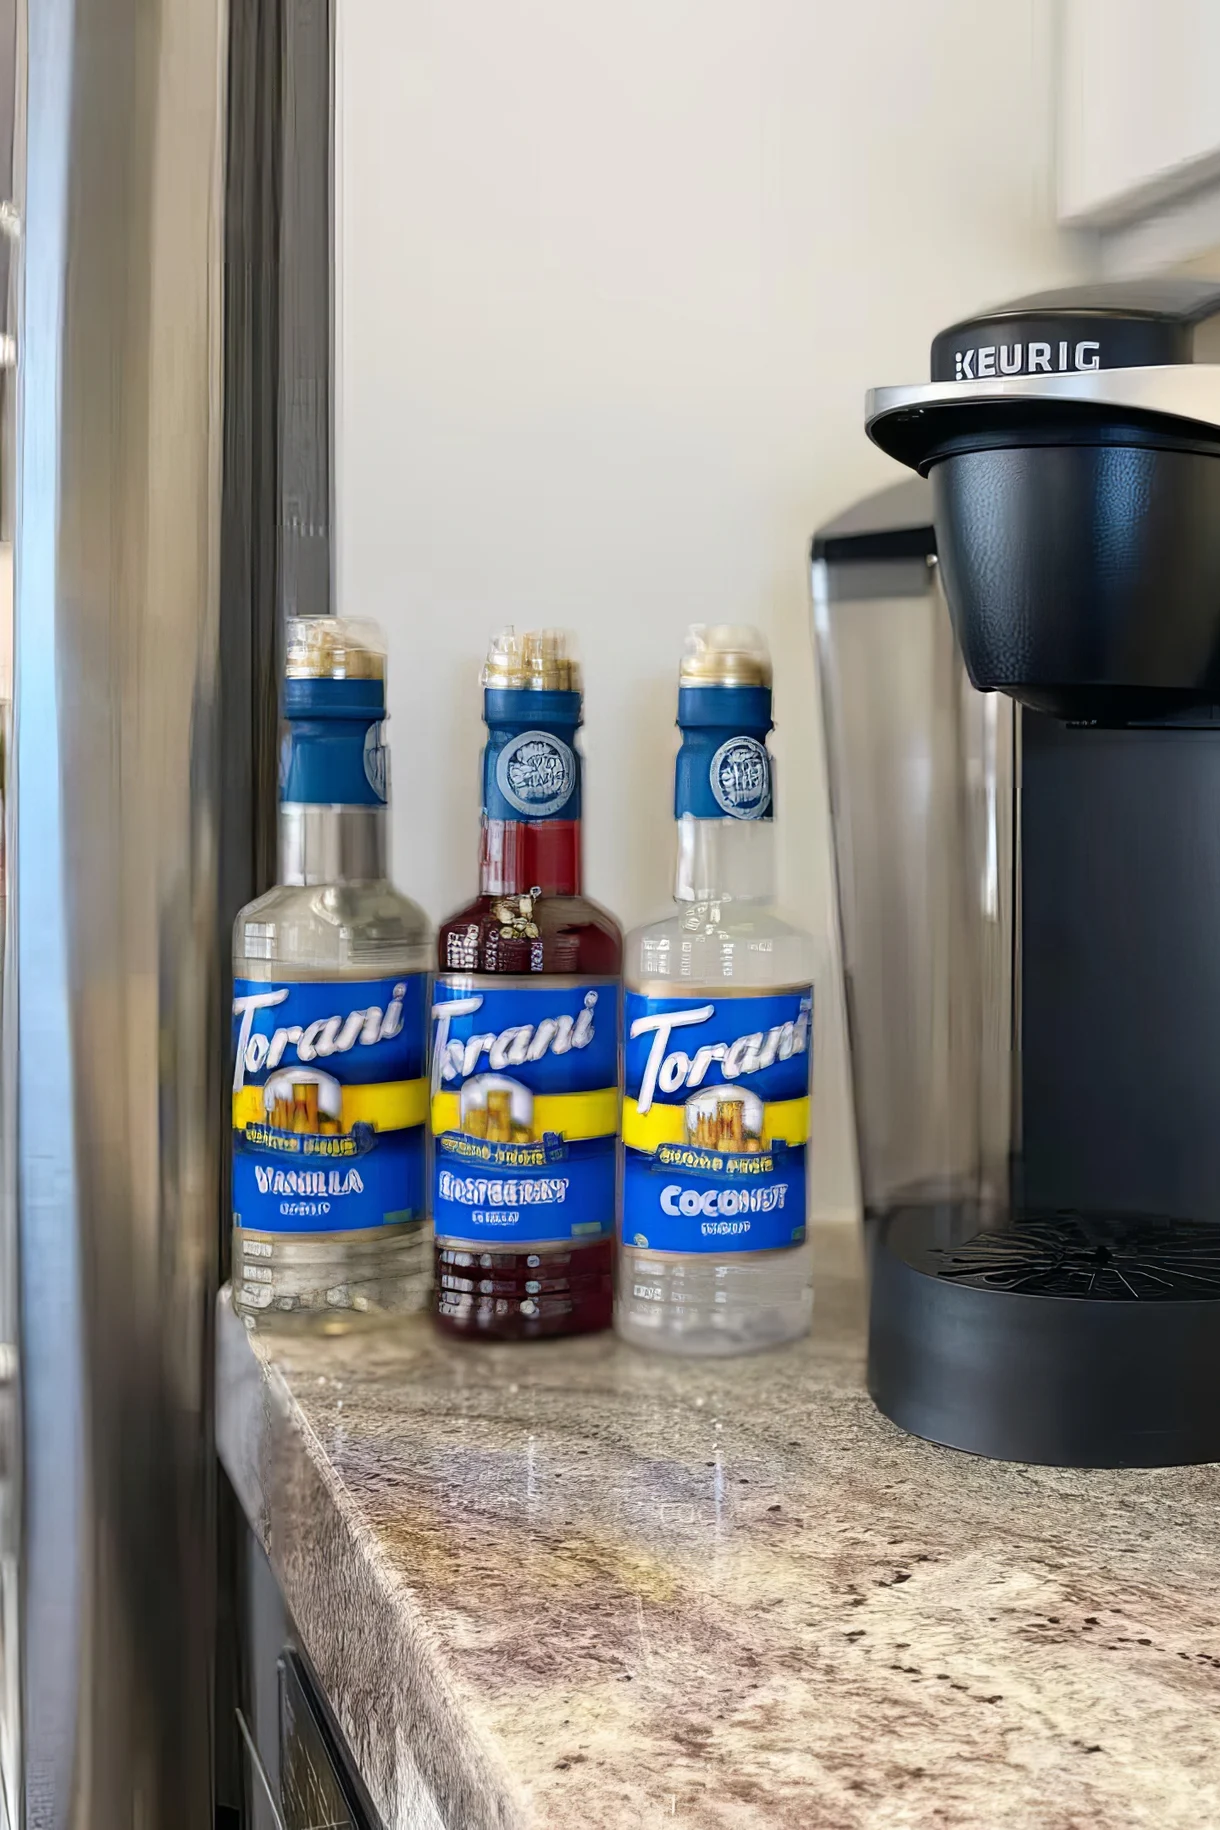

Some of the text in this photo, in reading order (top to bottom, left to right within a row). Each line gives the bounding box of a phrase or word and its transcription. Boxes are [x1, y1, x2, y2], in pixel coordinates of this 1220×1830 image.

[955, 341, 1100, 380] KEURIG
[233, 982, 408, 1093] Torani
[431, 990, 599, 1099] Torani
